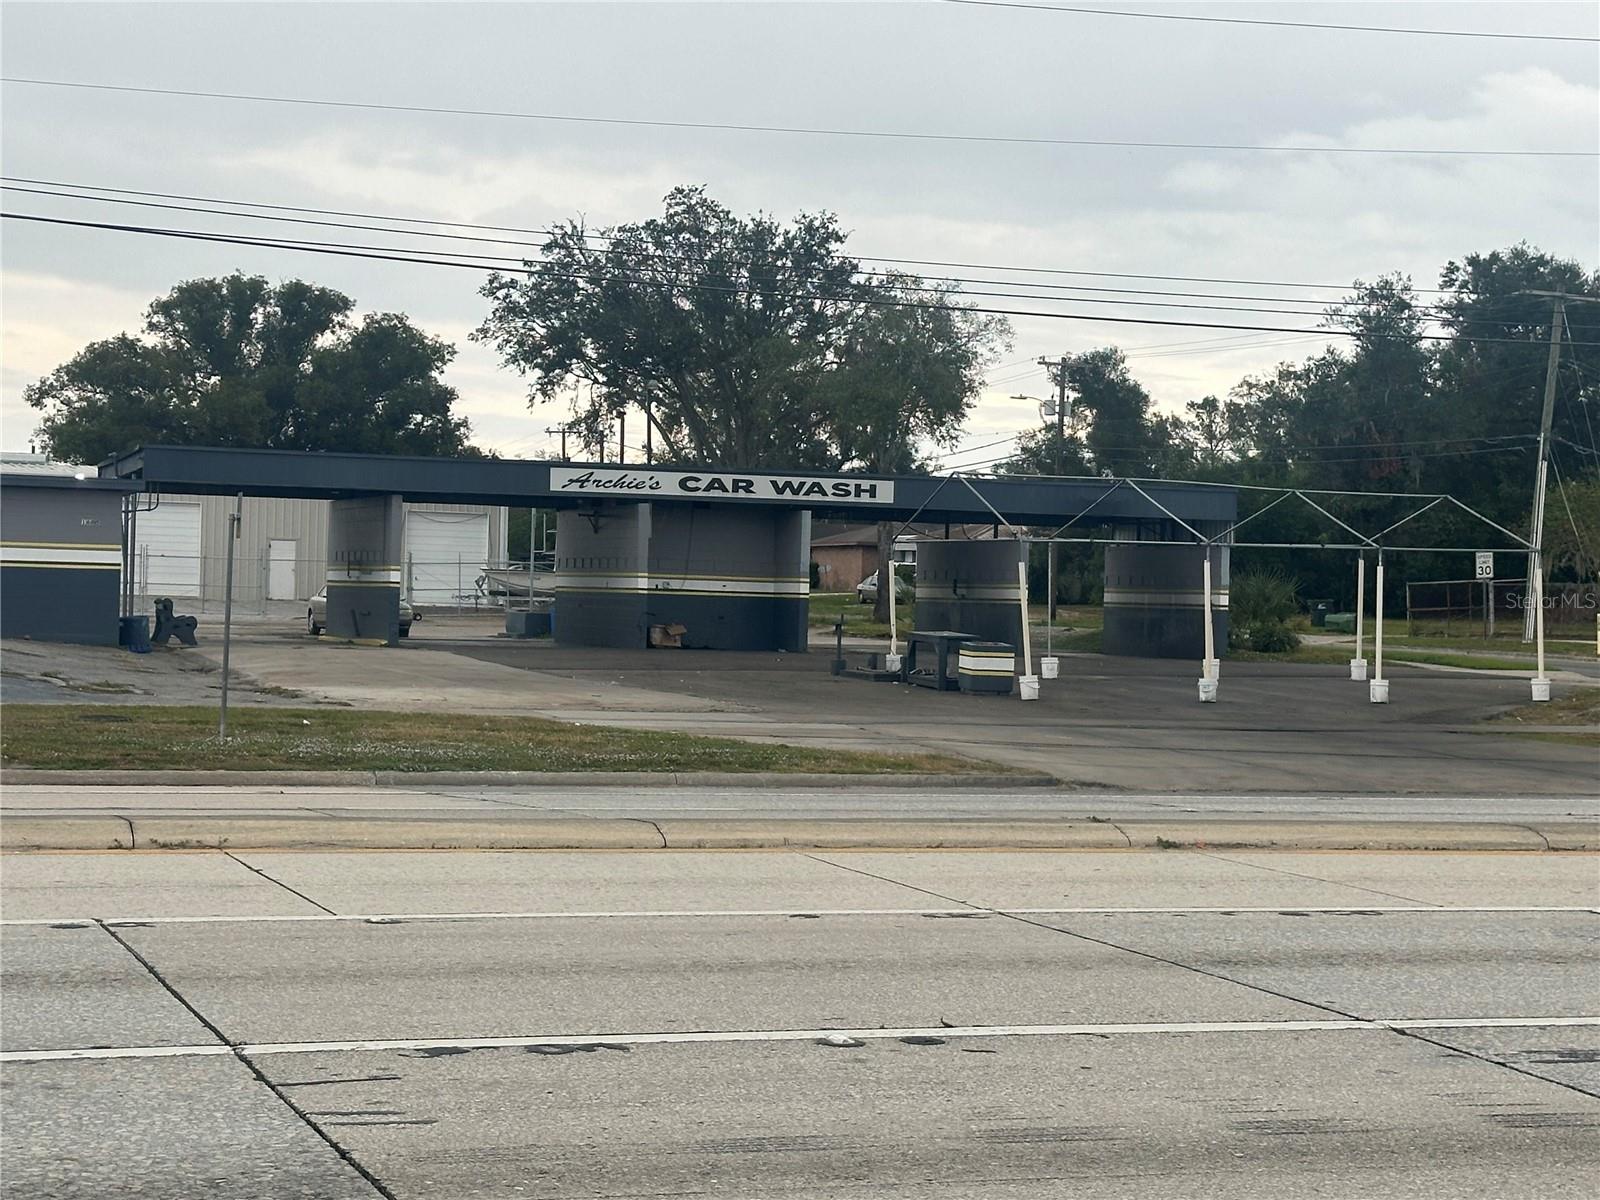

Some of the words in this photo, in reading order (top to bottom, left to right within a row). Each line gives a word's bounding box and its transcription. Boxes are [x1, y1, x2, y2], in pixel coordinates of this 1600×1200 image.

[562, 471, 661, 490] Archie's
[678, 475, 756, 494] CAR
[768, 479, 877, 498] WASH
[1478, 565, 1491, 575] 30
